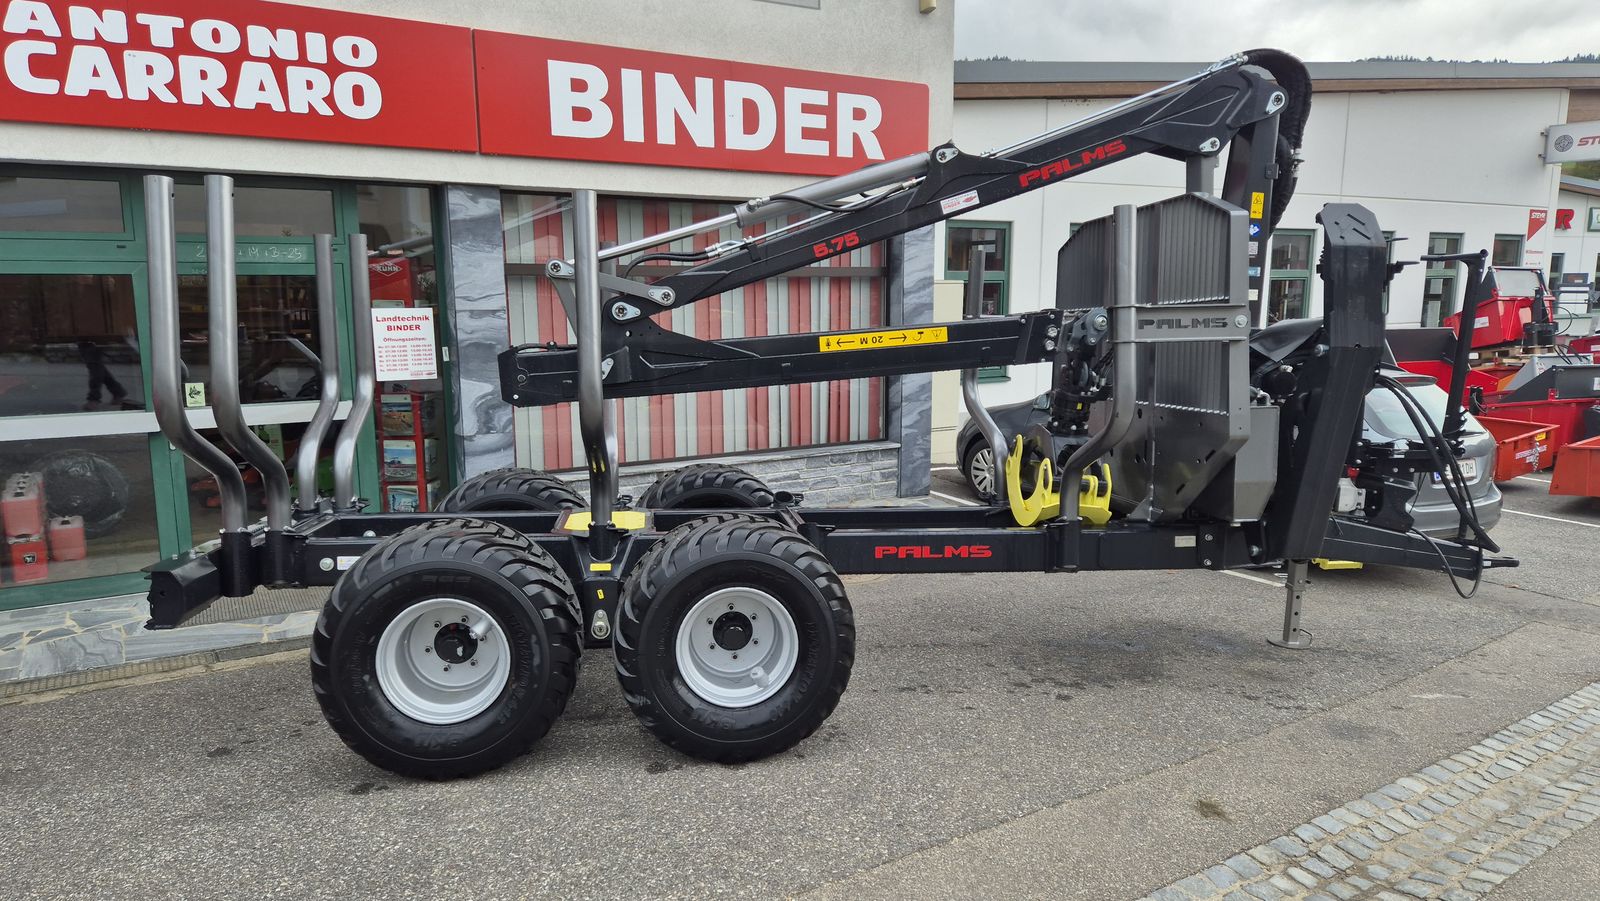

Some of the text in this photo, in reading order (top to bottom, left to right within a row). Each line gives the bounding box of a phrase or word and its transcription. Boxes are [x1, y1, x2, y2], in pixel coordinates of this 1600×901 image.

[2, 0, 378, 68] ANTONIO
[3, 39, 383, 120] CARRARO
[547, 59, 886, 161] BINDER
[1577, 135, 1600, 147] ST
[1019, 140, 1127, 188] PALMS
[812, 231, 861, 260] 5.75
[375, 314, 430, 322] Landtechnik
[1138, 317, 1229, 330] PALMS
[859, 335, 884, 345] 20 M
[873, 544, 994, 560] PALMS
